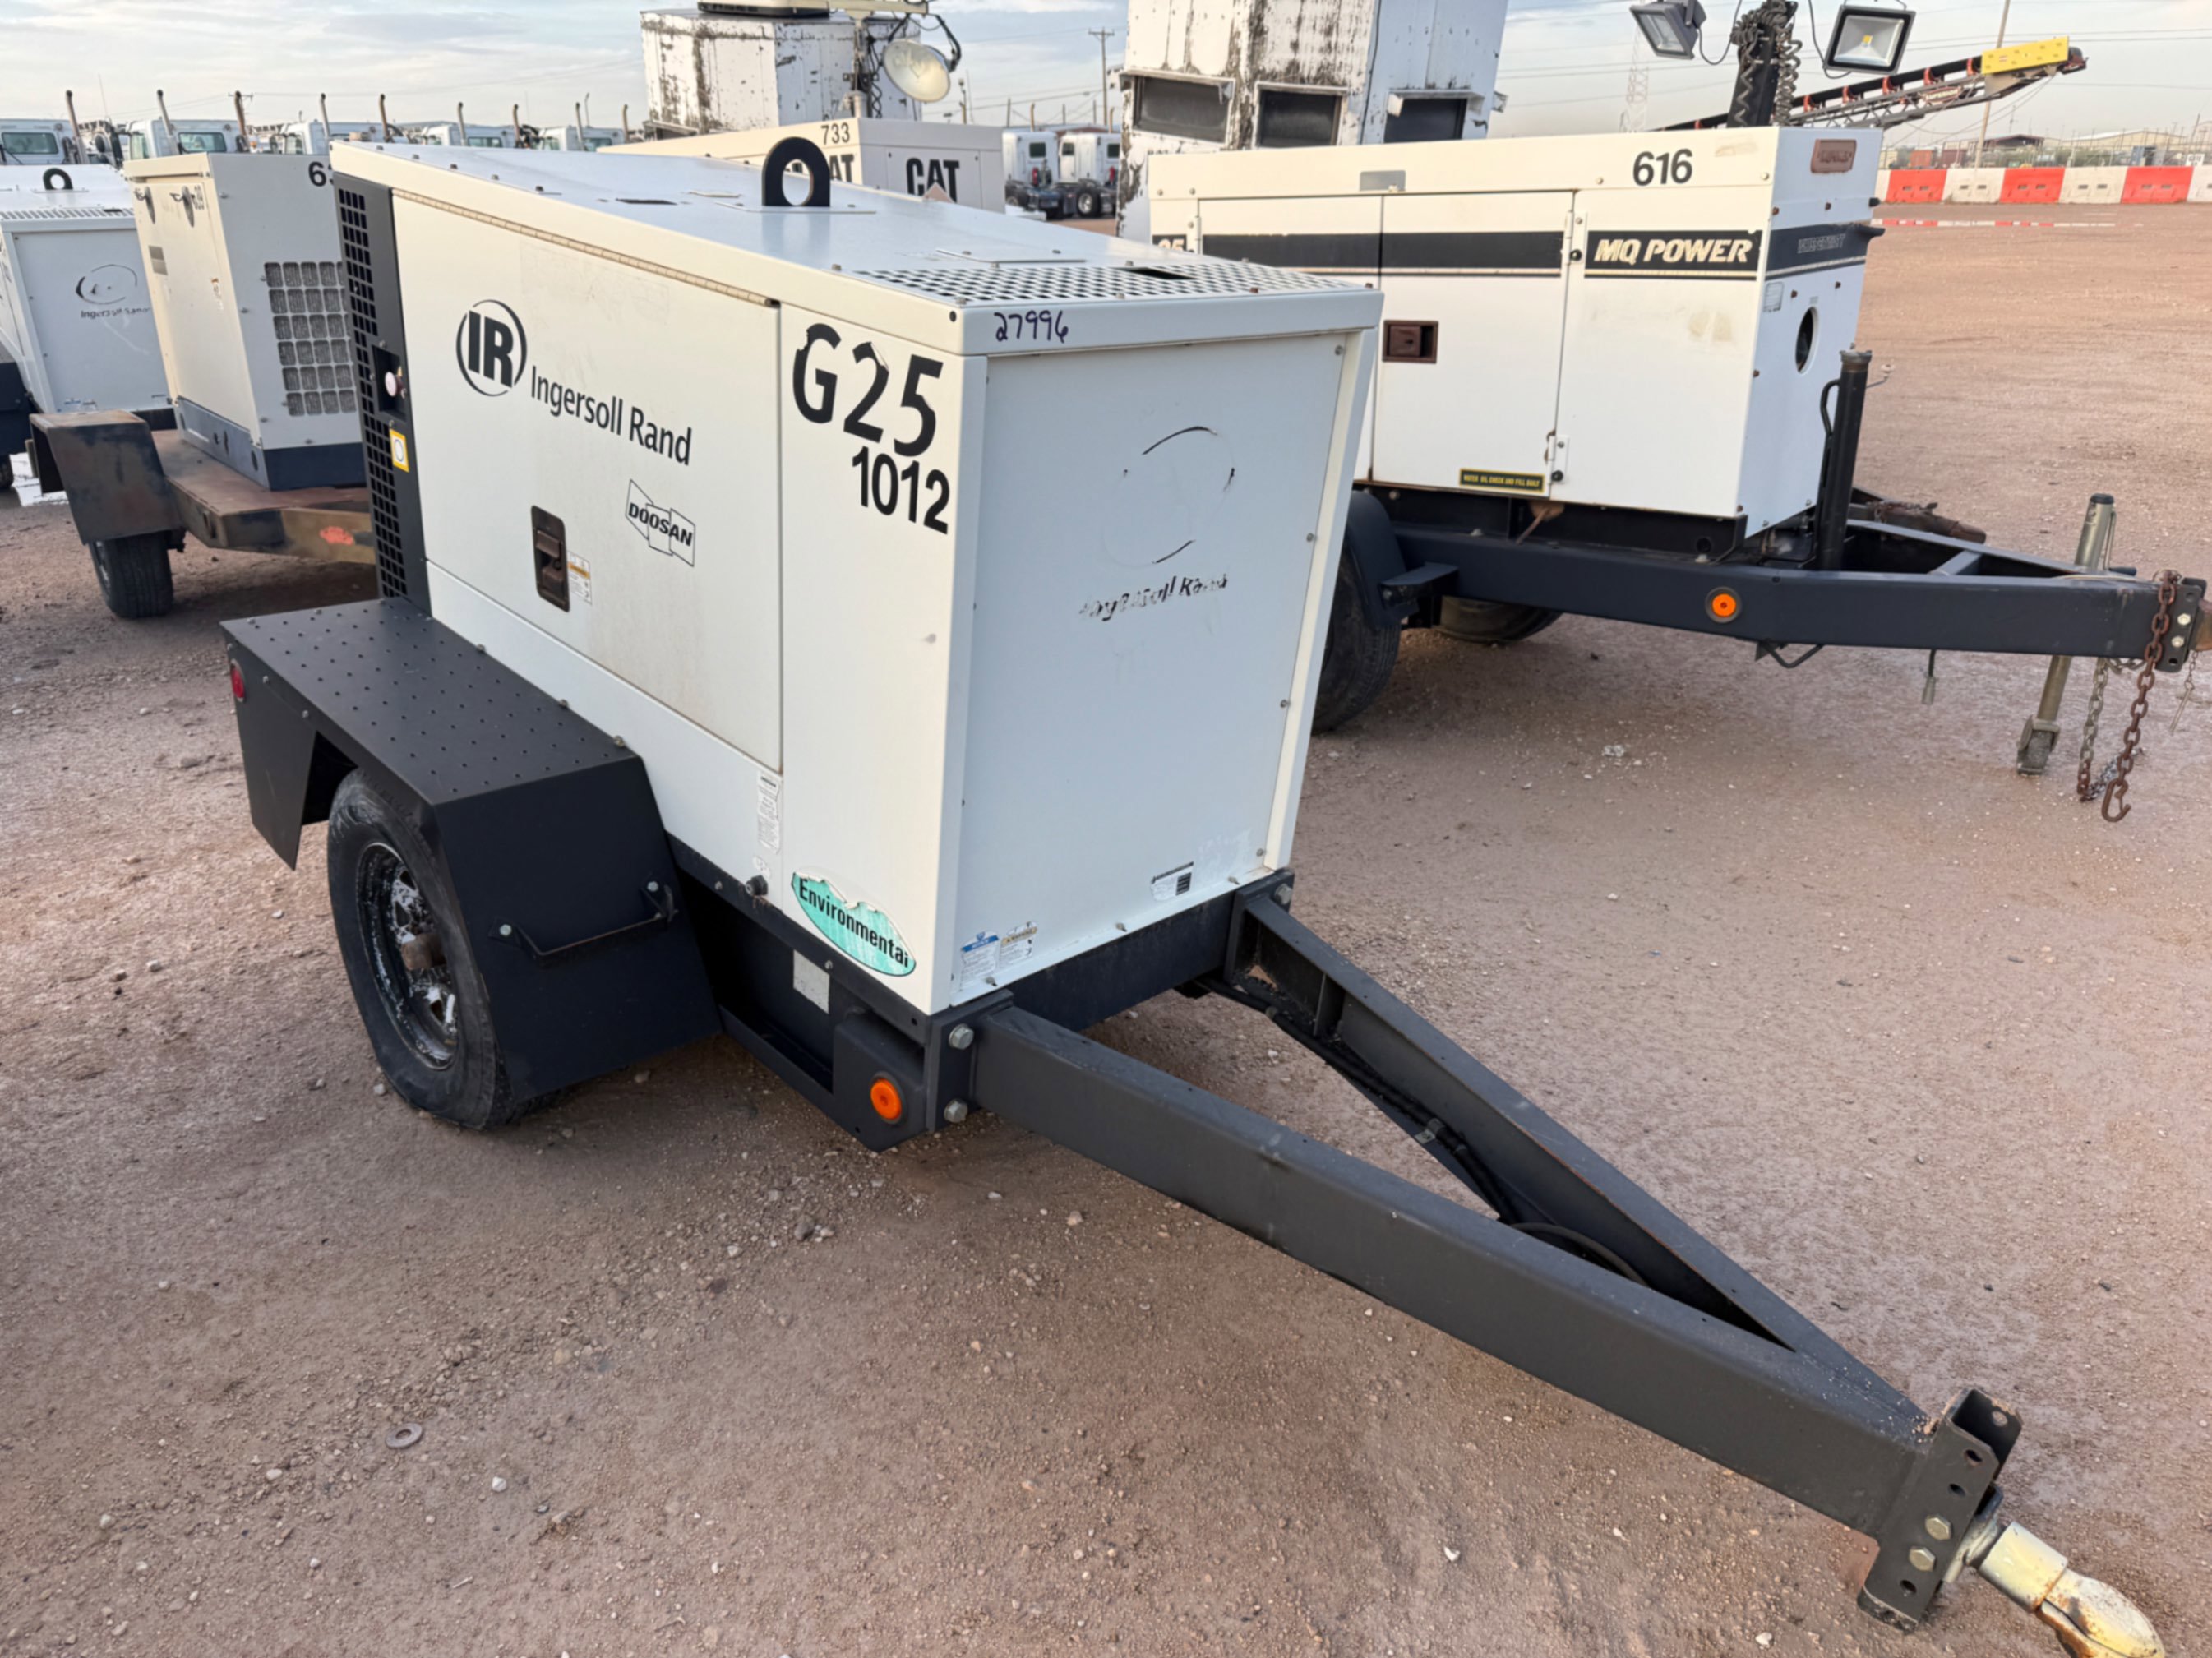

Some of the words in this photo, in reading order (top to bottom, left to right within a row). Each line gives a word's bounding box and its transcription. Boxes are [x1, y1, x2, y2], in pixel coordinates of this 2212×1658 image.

[821, 122, 851, 145] 733
[308, 161, 334, 187] 6
[829, 154, 855, 182] AT
[906, 158, 960, 203] CAT
[1632, 148, 1693, 187] 616
[1594, 238, 1642, 266] MQ
[1642, 238, 1753, 263] POWER
[466, 310, 515, 389] IR
[994, 310, 1069, 344] 27996
[792, 322, 944, 457] G25
[530, 365, 623, 436] Ingersoll
[629, 407, 693, 466] Rand
[852, 446, 950, 535] 1012
[628, 502, 694, 547] DOOSAN
[799, 877, 909, 968] Environmental
